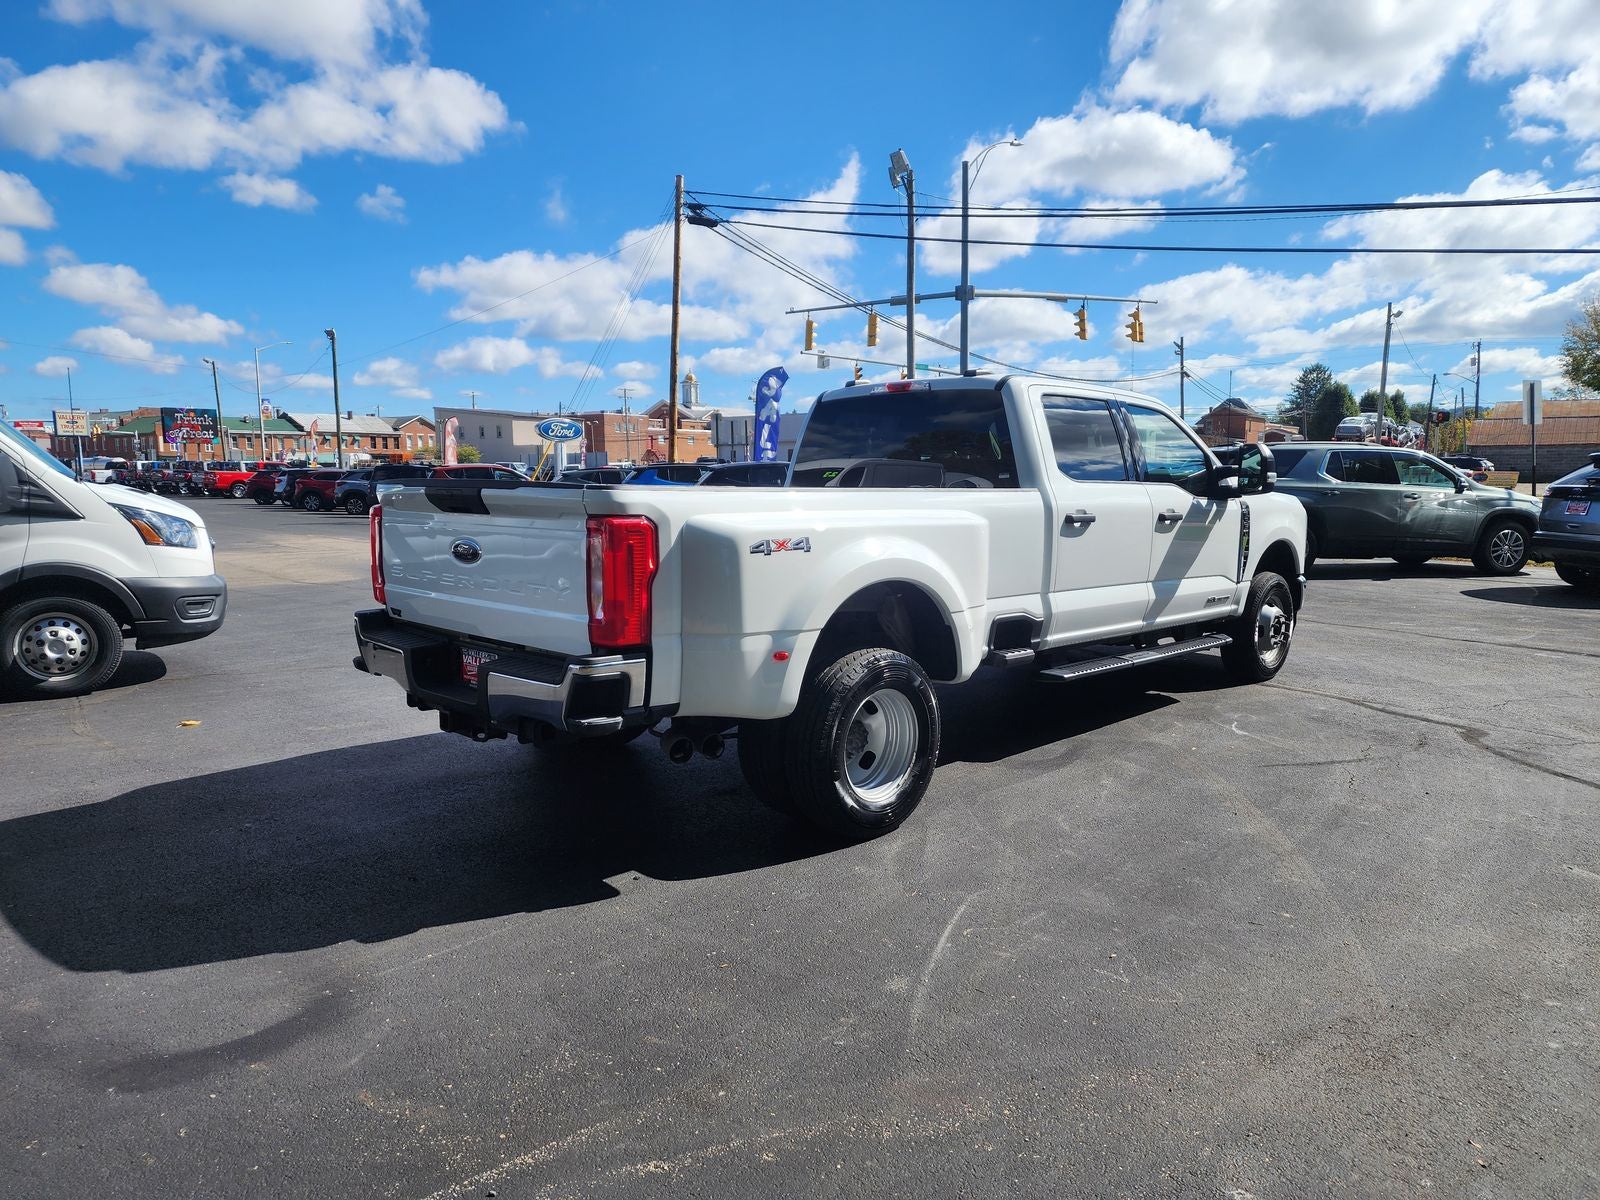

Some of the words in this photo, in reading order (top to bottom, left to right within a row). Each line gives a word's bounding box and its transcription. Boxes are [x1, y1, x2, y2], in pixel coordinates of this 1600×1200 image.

[174, 413, 213, 425] Trunk
[180, 427, 215, 439] Treat
[548, 422, 576, 437] Ford
[391, 565, 476, 589] SUPER
[462, 654, 491, 666] VALLE
